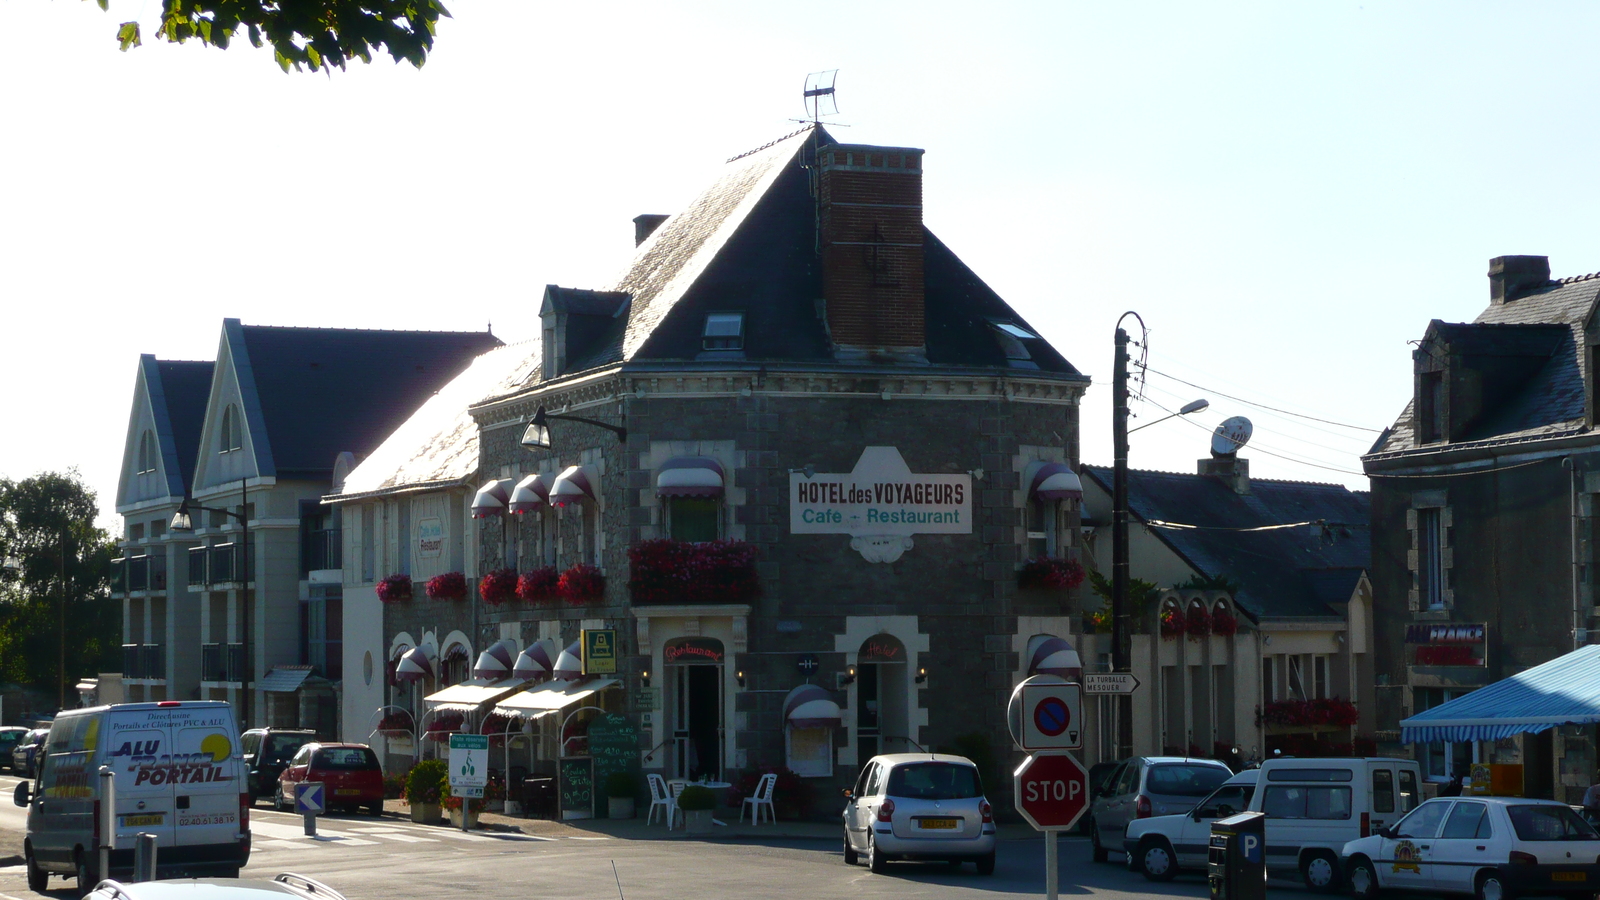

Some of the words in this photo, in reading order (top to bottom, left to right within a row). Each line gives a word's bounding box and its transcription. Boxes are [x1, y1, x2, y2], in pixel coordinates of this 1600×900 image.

[798, 482, 847, 504] HOTEL
[849, 482, 872, 504] des
[874, 483, 964, 505] VOYAGEURS
[867, 508, 960, 524] Restaurant
[1429, 623, 1483, 643] FRANCE
[113, 722, 141, 730] Portails
[183, 719, 199, 727] PVC
[201, 719, 207, 727] &
[208, 718, 226, 726] ALU
[147, 713, 171, 721] Direct
[110, 740, 160, 757] ALU
[134, 767, 234, 786] PORTAIL
[1026, 780, 1081, 801] STOP
[1244, 835, 1258, 858] P
